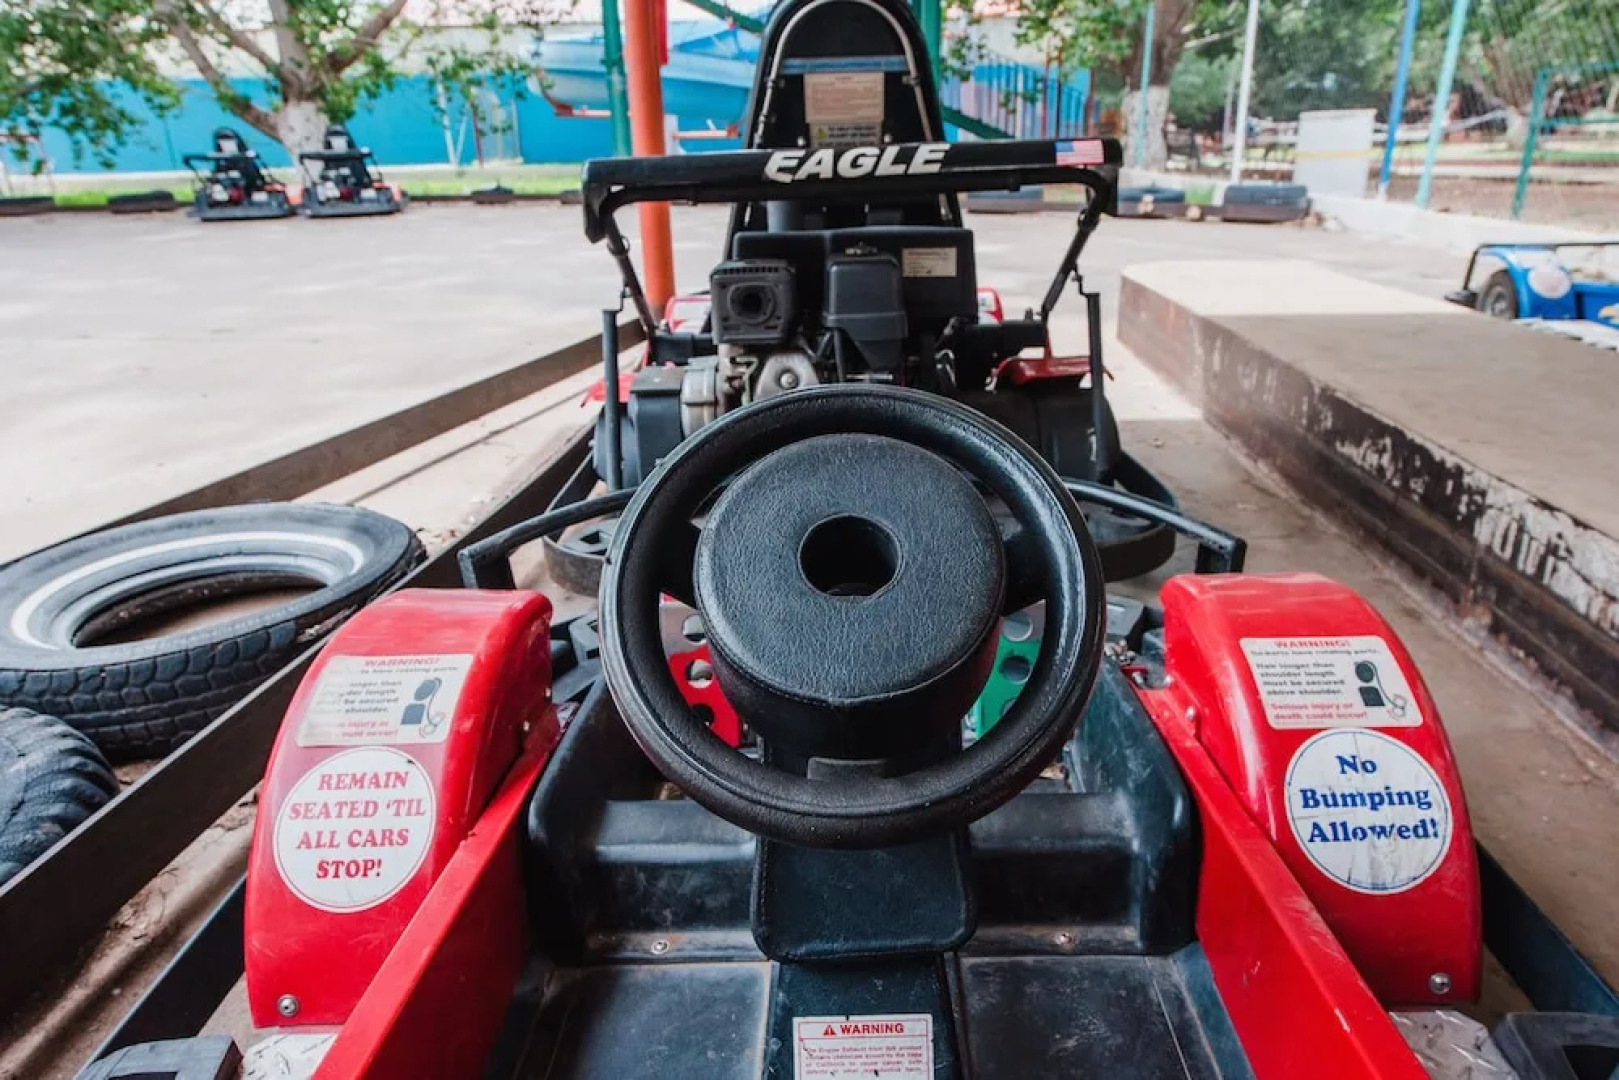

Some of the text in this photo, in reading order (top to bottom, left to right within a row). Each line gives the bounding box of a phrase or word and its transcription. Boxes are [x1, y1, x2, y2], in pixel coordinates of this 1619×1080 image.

[764, 144, 951, 183] EAGLE
[1274, 640, 1350, 648] WARNING!
[364, 658, 440, 667] WARNING!
[1336, 755, 1377, 774] No
[317, 771, 409, 791] REMAIN
[1300, 785, 1432, 811] Bumping
[288, 800, 379, 820] SEATED
[296, 828, 409, 849] ALL CARS
[1307, 818, 1439, 842] Allowed!
[316, 858, 382, 879] STOP!
[840, 1023, 904, 1034] WARNING
